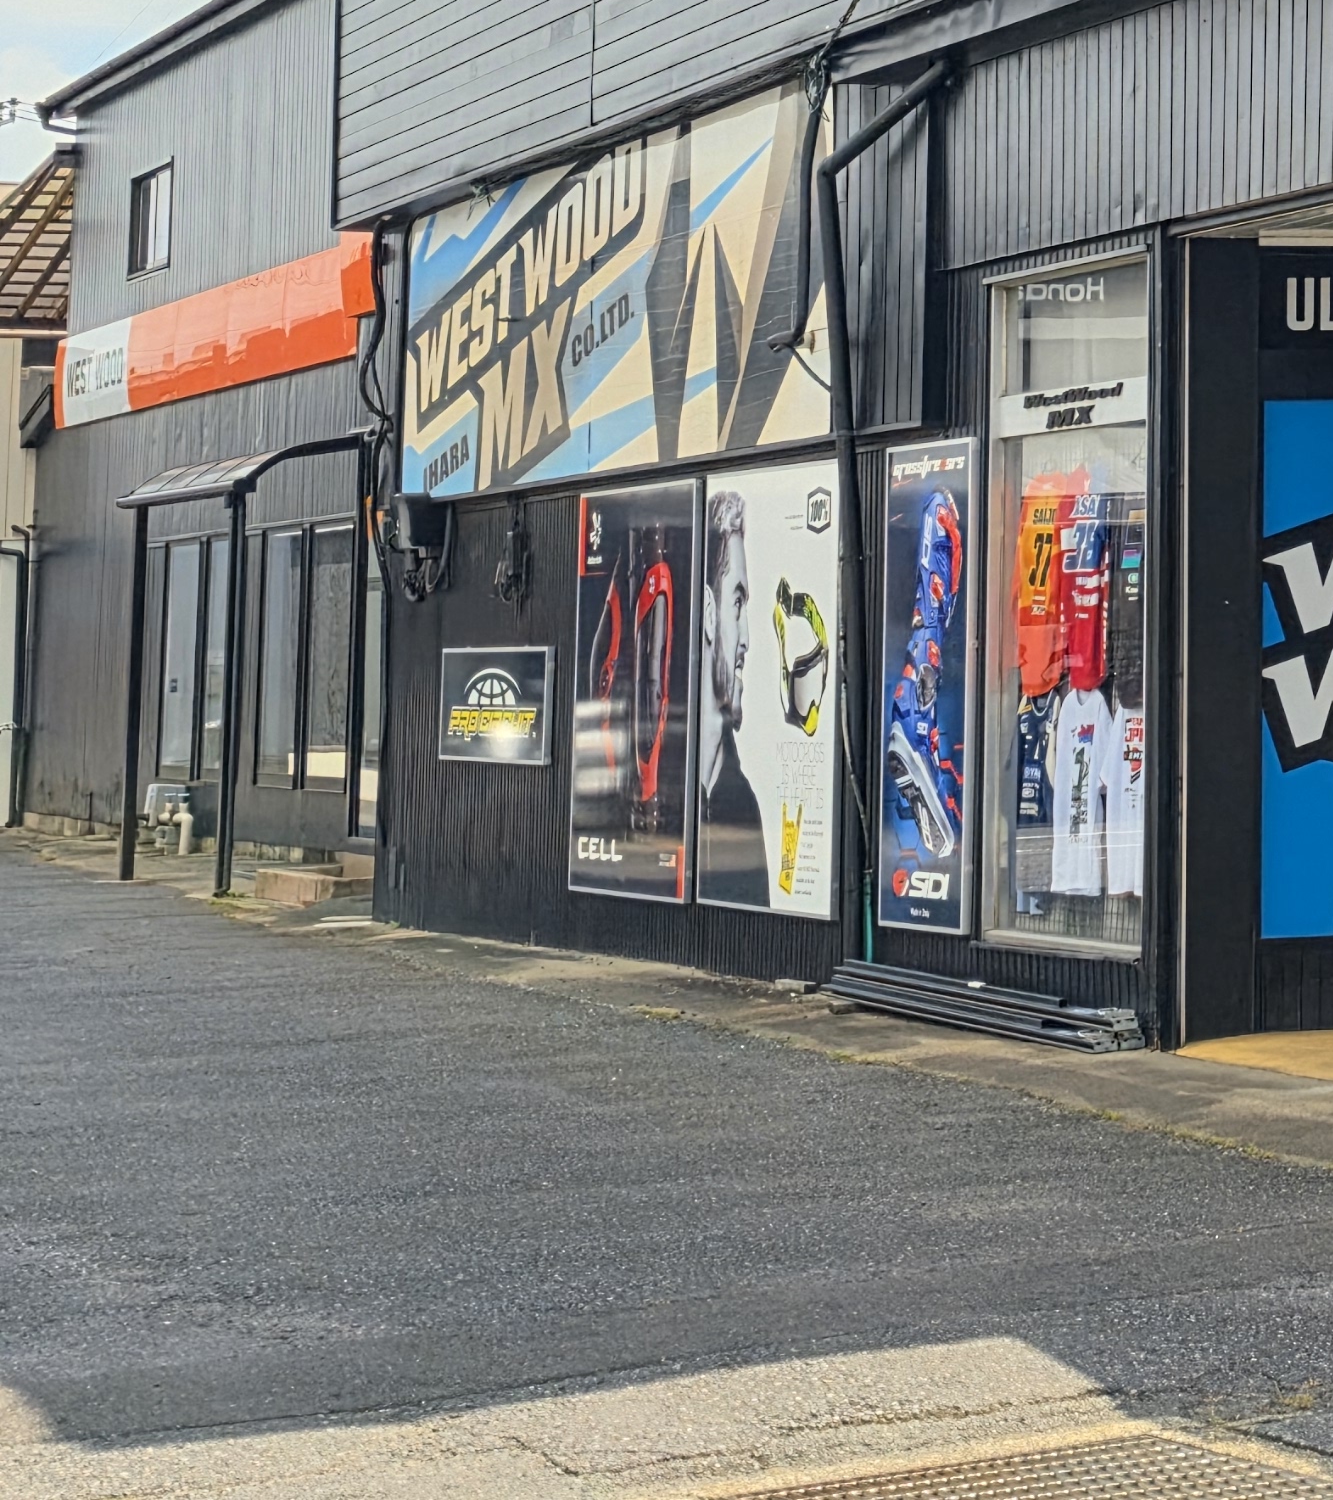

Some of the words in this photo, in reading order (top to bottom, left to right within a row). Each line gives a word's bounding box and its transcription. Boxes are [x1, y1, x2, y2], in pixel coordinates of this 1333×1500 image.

[66, 356, 93, 398] WEST
[95, 347, 124, 390] WOOD
[477, 297, 572, 492] MX
[1046, 404, 1096, 429] MX
[776, 741, 825, 764] MOTOCROSS
[577, 836, 623, 862] CELL
